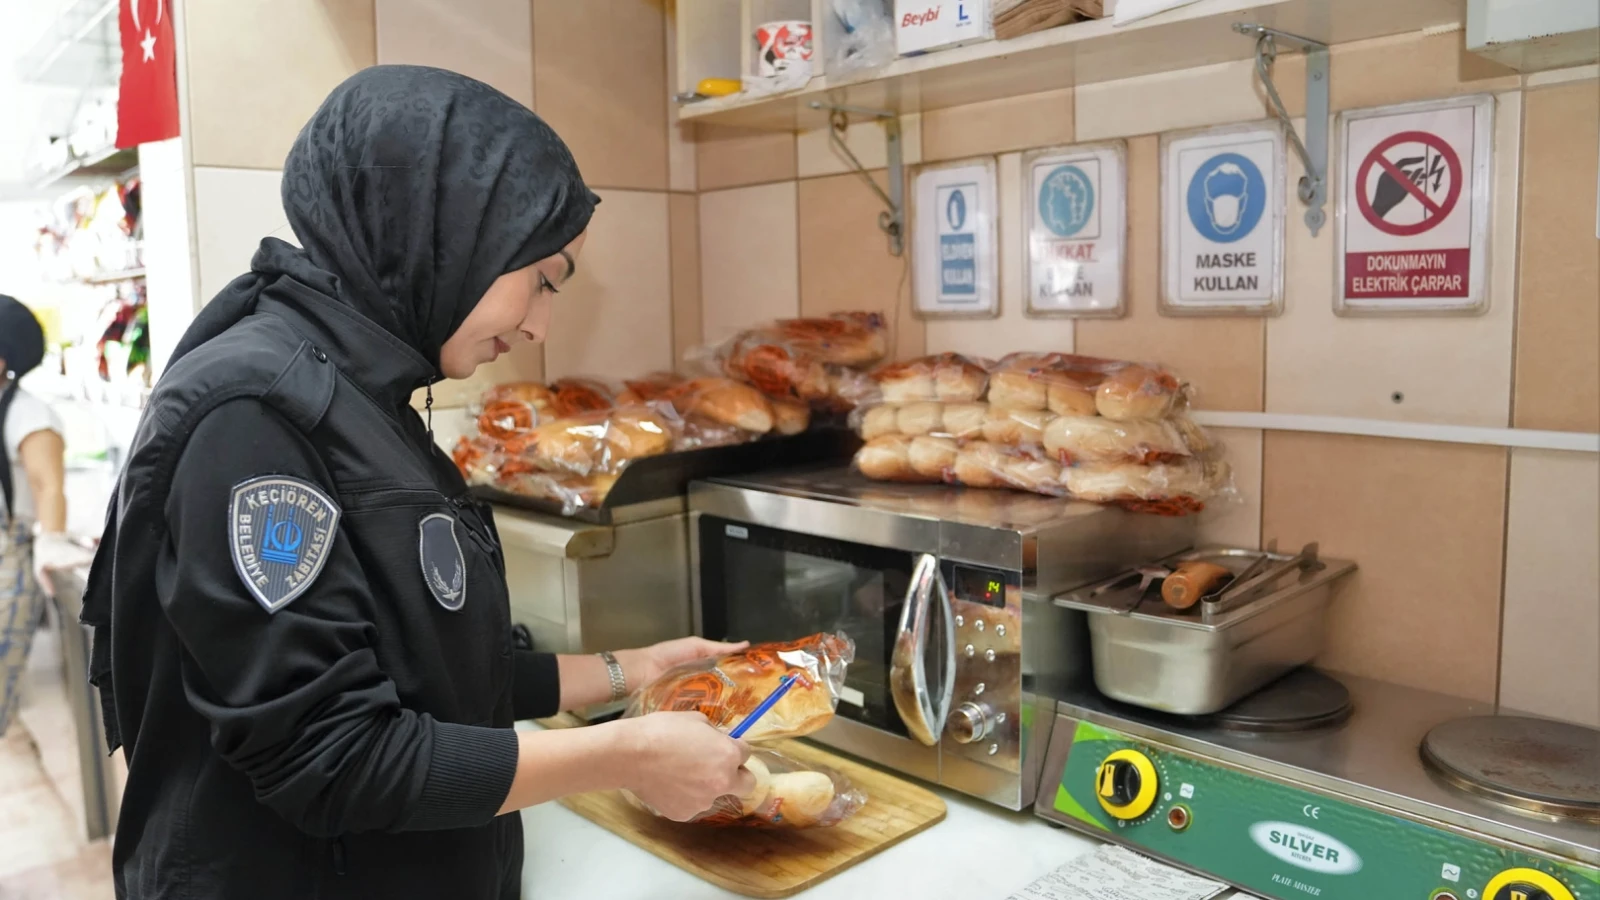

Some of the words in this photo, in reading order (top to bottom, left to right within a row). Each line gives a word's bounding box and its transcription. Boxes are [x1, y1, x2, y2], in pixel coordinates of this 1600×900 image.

[902, 4, 942, 28] Beybi
[959, 4, 969, 21] L
[1196, 252, 1256, 269] MASKE
[1367, 254, 1447, 271] DOKUNMAYIN
[1194, 276, 1258, 291] KULLAN
[1352, 273, 1409, 292] ELEKTRİK
[1411, 275, 1462, 295] ÇARPAR
[246, 485, 327, 522] KEÇİÖREN
[239, 514, 269, 588] BELEDİYE
[285, 527, 327, 589] ZABITASI
[988, 581, 1000, 593] 14
[1268, 830, 1340, 863] SILVER
[1292, 881, 1322, 896] MASTER
